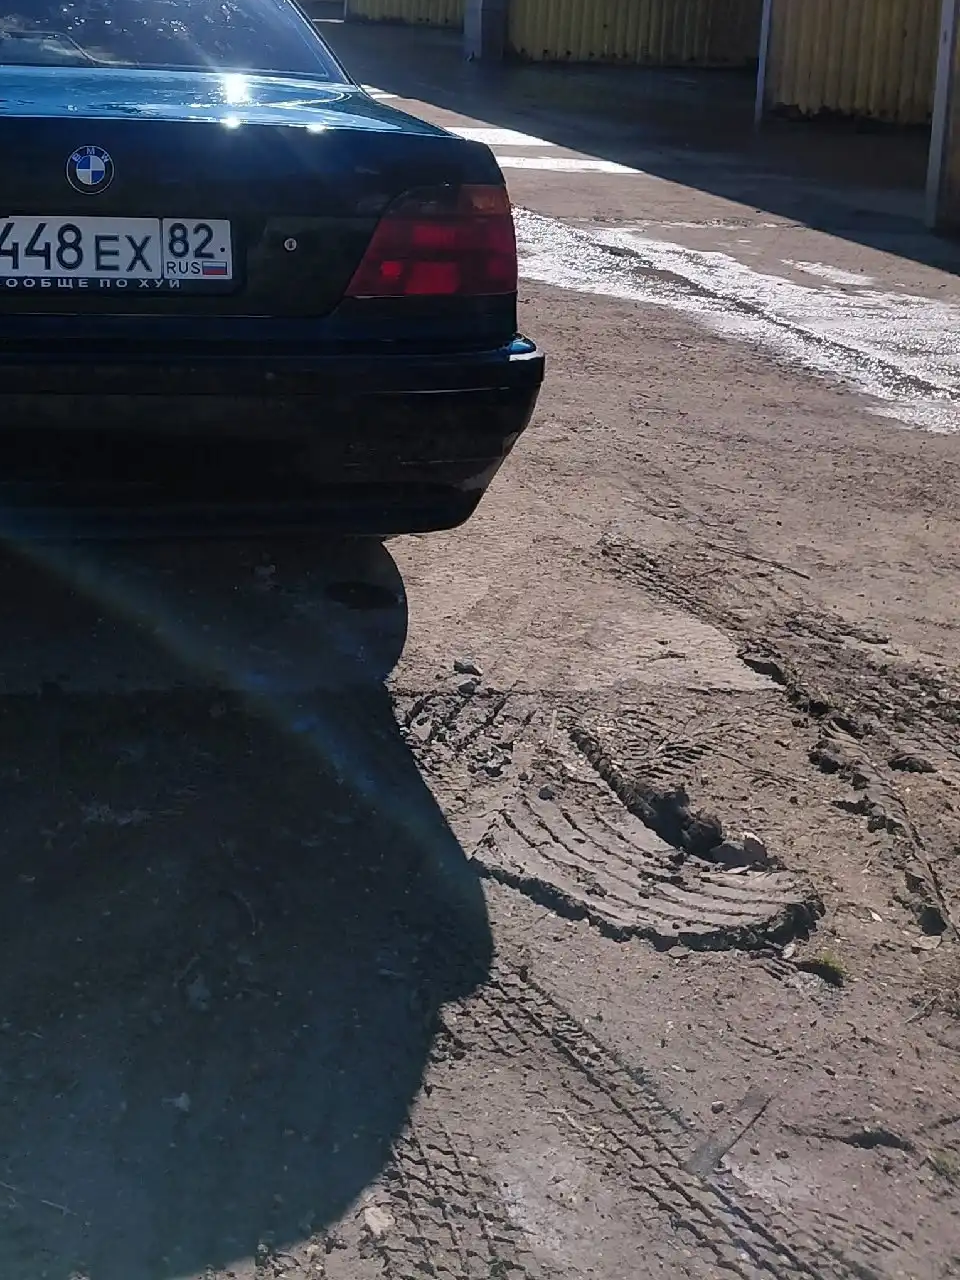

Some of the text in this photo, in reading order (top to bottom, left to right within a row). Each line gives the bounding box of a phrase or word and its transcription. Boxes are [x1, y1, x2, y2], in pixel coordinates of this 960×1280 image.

[71, 147, 110, 163] BMW
[168, 222, 215, 259] 82
[166, 261, 201, 275] RUS
[99, 278, 128, 288] ПО
